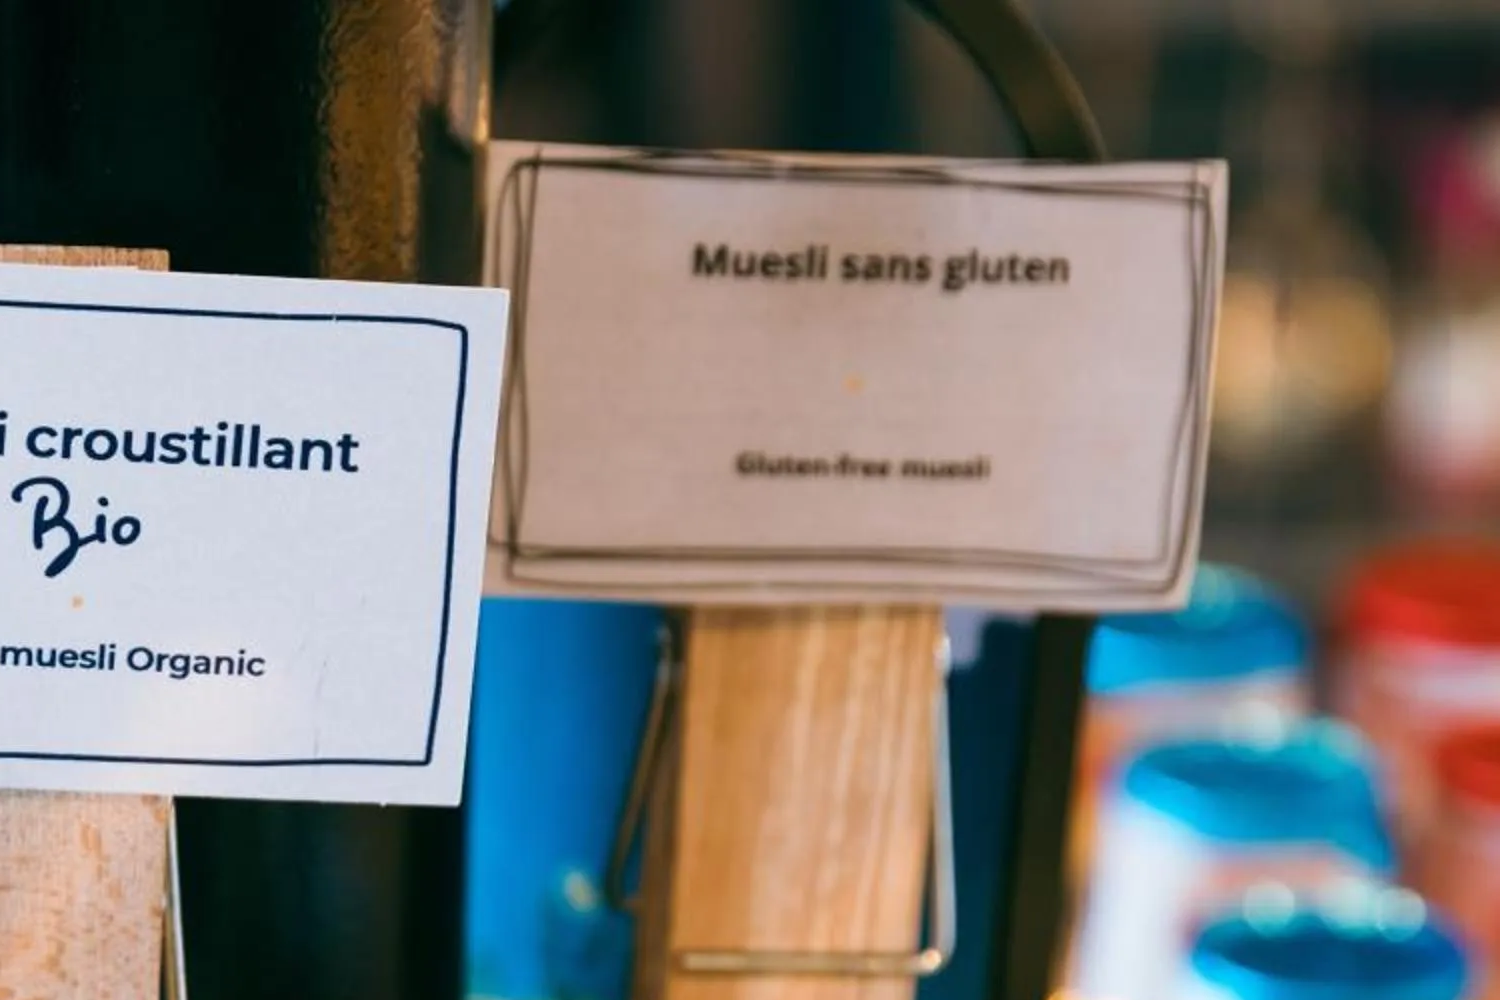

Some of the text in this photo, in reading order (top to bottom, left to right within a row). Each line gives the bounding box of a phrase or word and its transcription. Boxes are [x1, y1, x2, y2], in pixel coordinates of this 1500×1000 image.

[691, 243, 1071, 295] Muesli sans gluten
[25, 420, 360, 474] croustillant
[734, 451, 992, 481] Gluten-free muesli
[11, 476, 142, 578] Bio
[0, 643, 117, 671] muesli
[125, 646, 267, 680] Organic
